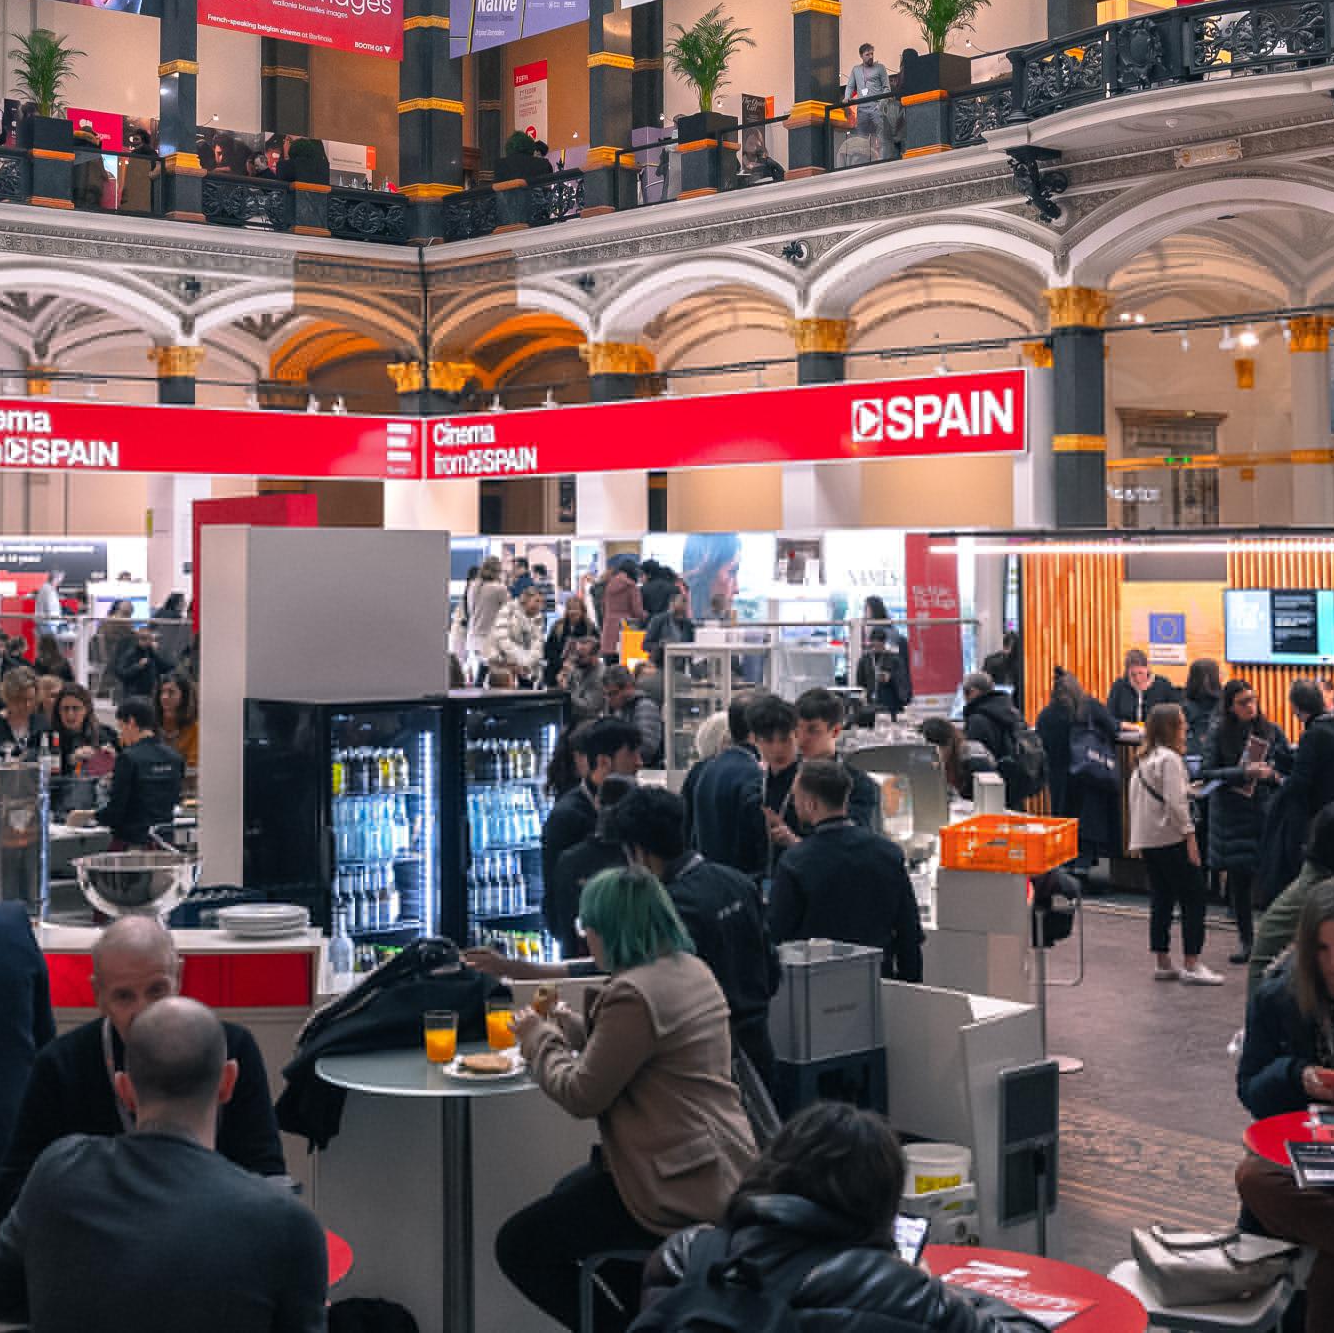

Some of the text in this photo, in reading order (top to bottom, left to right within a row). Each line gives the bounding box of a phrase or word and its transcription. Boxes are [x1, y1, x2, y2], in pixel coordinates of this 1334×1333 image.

[272, 0, 298, 10] wallonia
[326, 7, 348, 19] images
[280, 28, 301, 37] cinema
[885, 387, 1015, 441] SPAIN
[433, 421, 495, 447] Cinema
[31, 439, 119, 467] SPAIN
[482, 446, 538, 474] SPAIN
